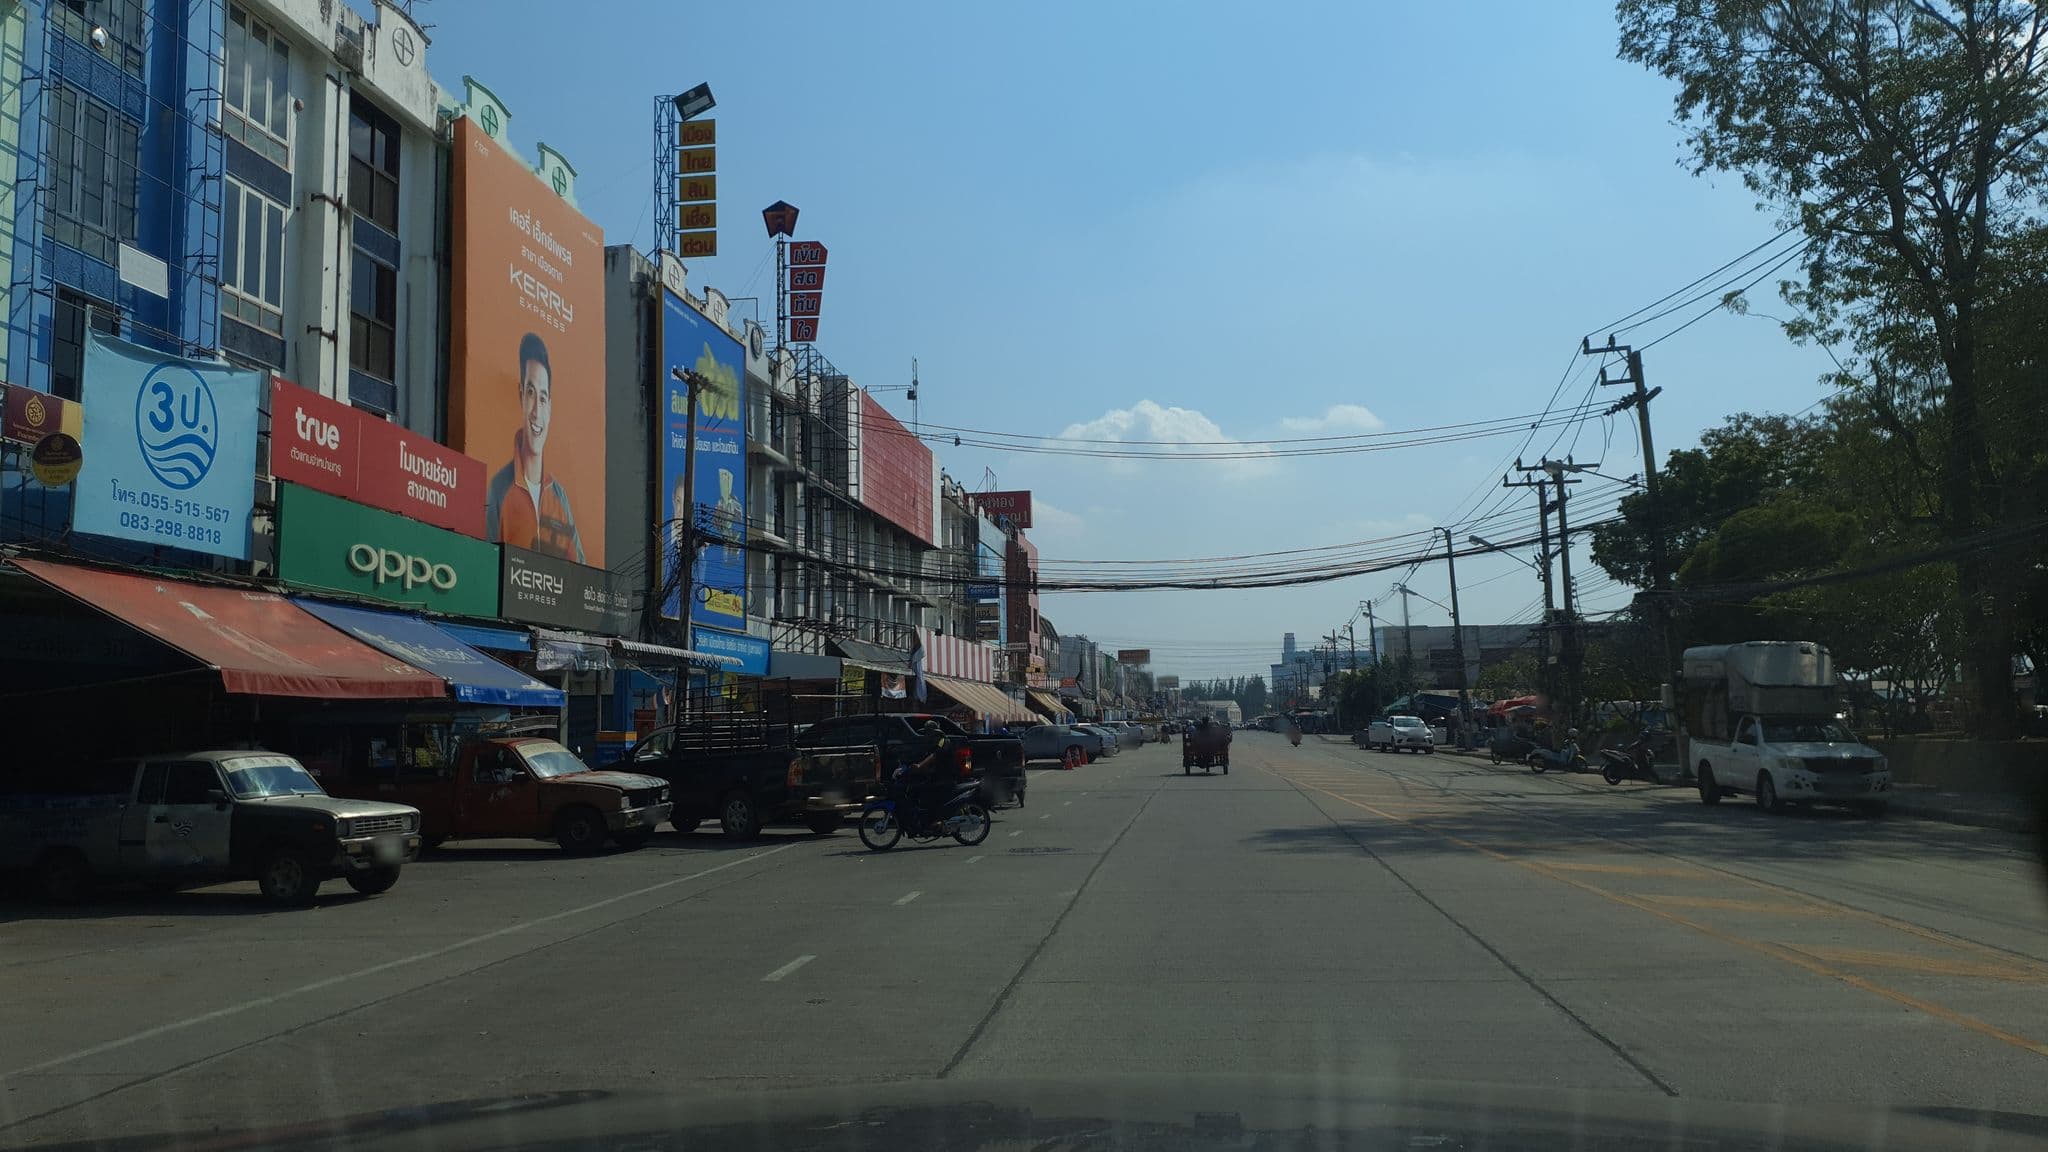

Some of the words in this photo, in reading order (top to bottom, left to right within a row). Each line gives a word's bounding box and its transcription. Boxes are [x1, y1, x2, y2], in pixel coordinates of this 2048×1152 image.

[684, 151, 712, 170] ไทย
[510, 206, 531, 235] เคอรี่
[793, 243, 821, 263] เงิน
[793, 270, 818, 286] สด
[509, 263, 574, 324] KERRY
[793, 294, 817, 312] ทัน
[519, 296, 566, 333] EXPRESS
[796, 319, 812, 340] ใจ
[295, 406, 340, 450] true
[407, 480, 447, 509] สาขาตาก
[120, 511, 222, 545] 083-298-8818
[510, 566, 564, 595] KERRY
[517, 591, 557, 606] EXPRESS
